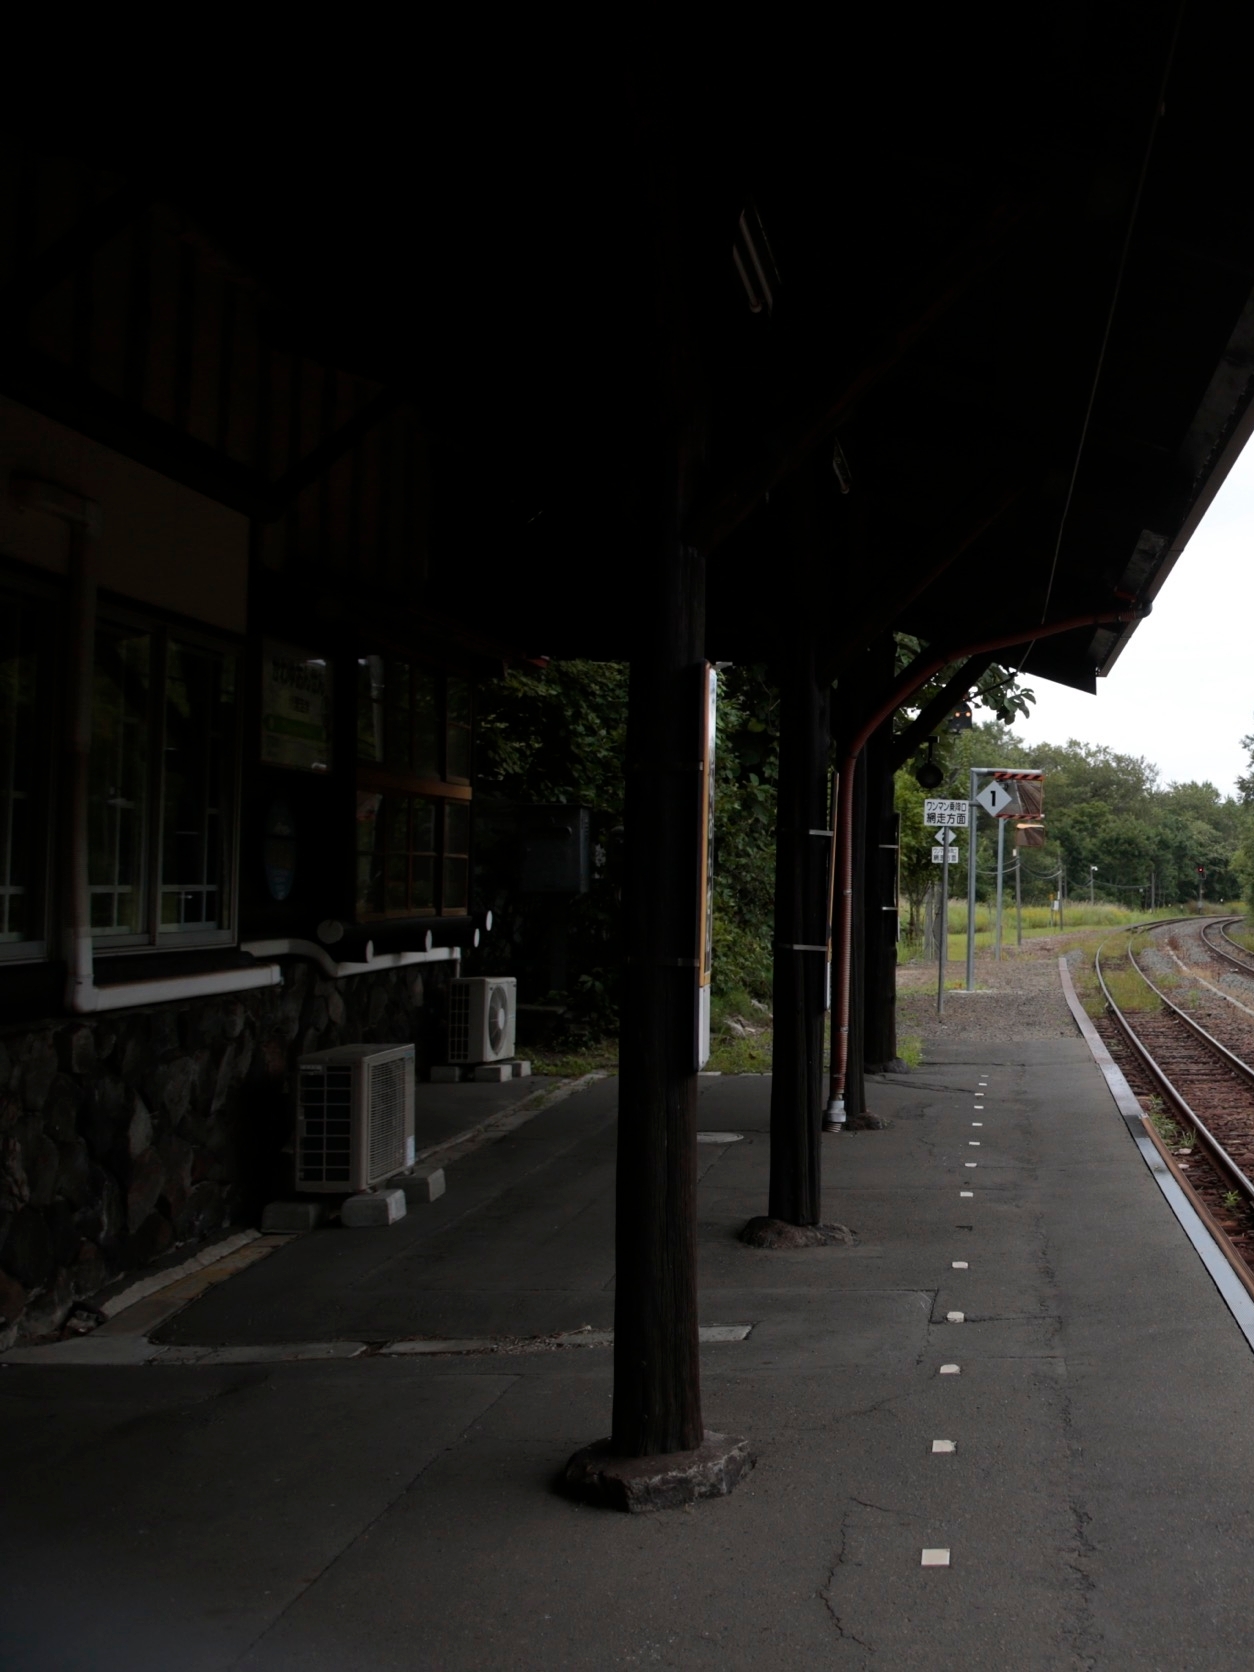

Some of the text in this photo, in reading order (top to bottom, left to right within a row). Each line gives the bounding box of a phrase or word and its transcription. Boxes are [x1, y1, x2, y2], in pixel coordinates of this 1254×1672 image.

[990, 791, 996, 806] 1
[926, 802, 966, 811] ワンマン乗降口
[926, 812, 966, 824] 網走方面
